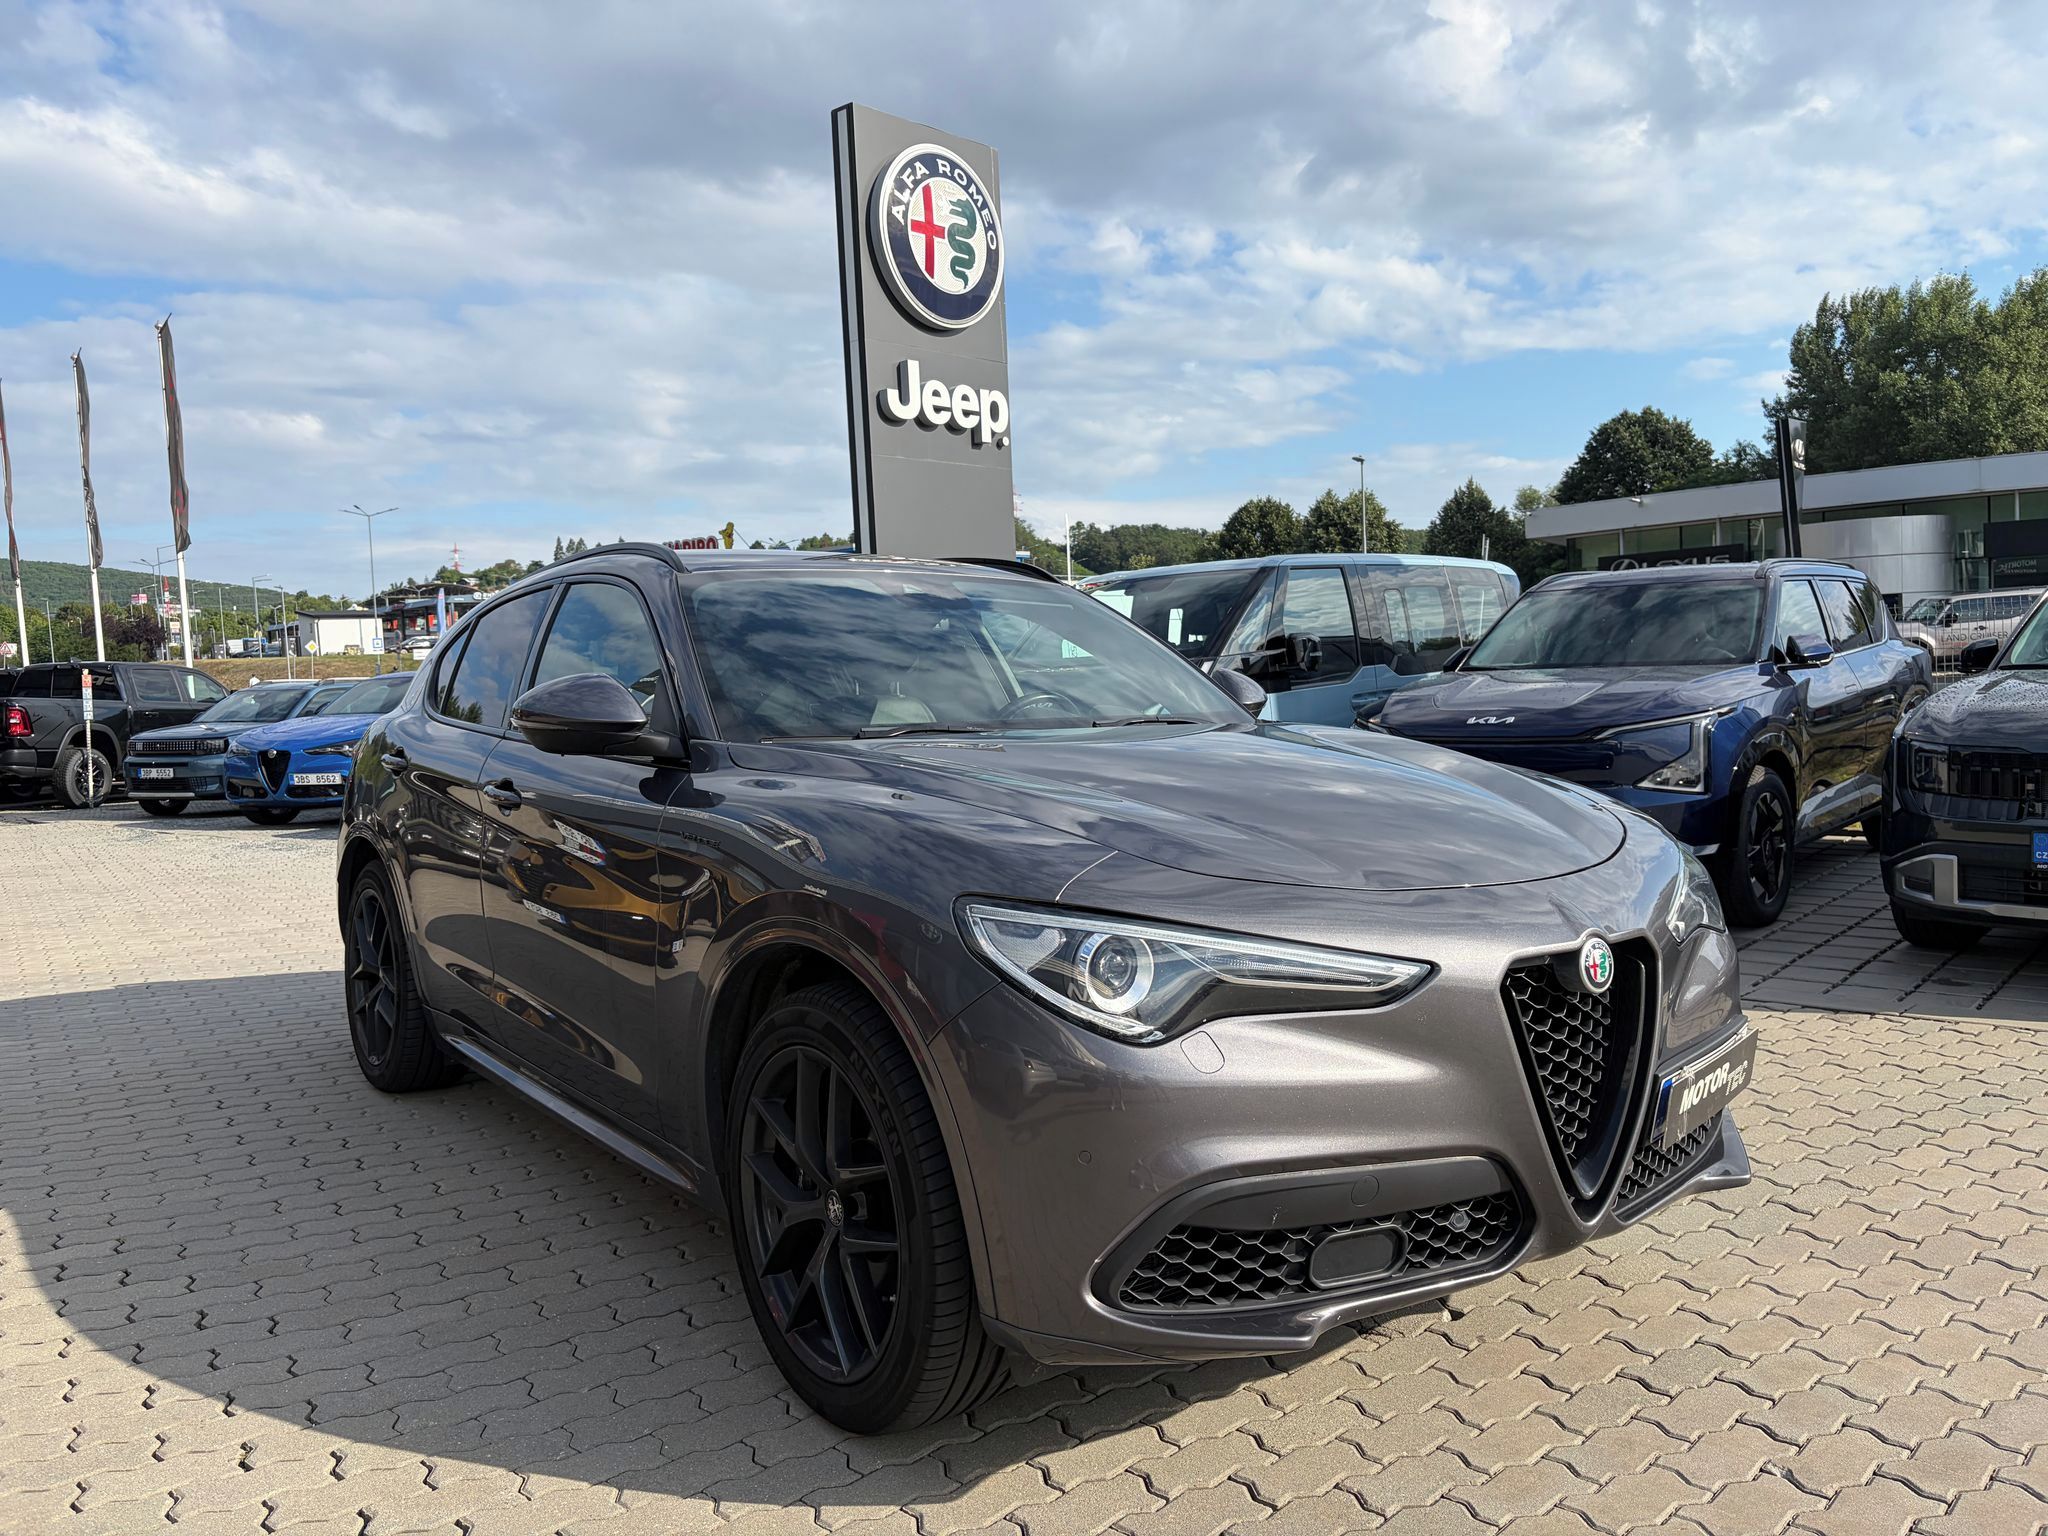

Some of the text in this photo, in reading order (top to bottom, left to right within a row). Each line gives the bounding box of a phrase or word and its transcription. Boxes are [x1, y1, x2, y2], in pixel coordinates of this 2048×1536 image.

[891, 158, 997, 250] ALFA ROMEO
[1941, 631, 2009, 642] LAND CRUISER
[295, 774, 337, 784] 3BS 8562
[2035, 851, 2048, 859] CZ
[1678, 1061, 1731, 1115] MOTOR
